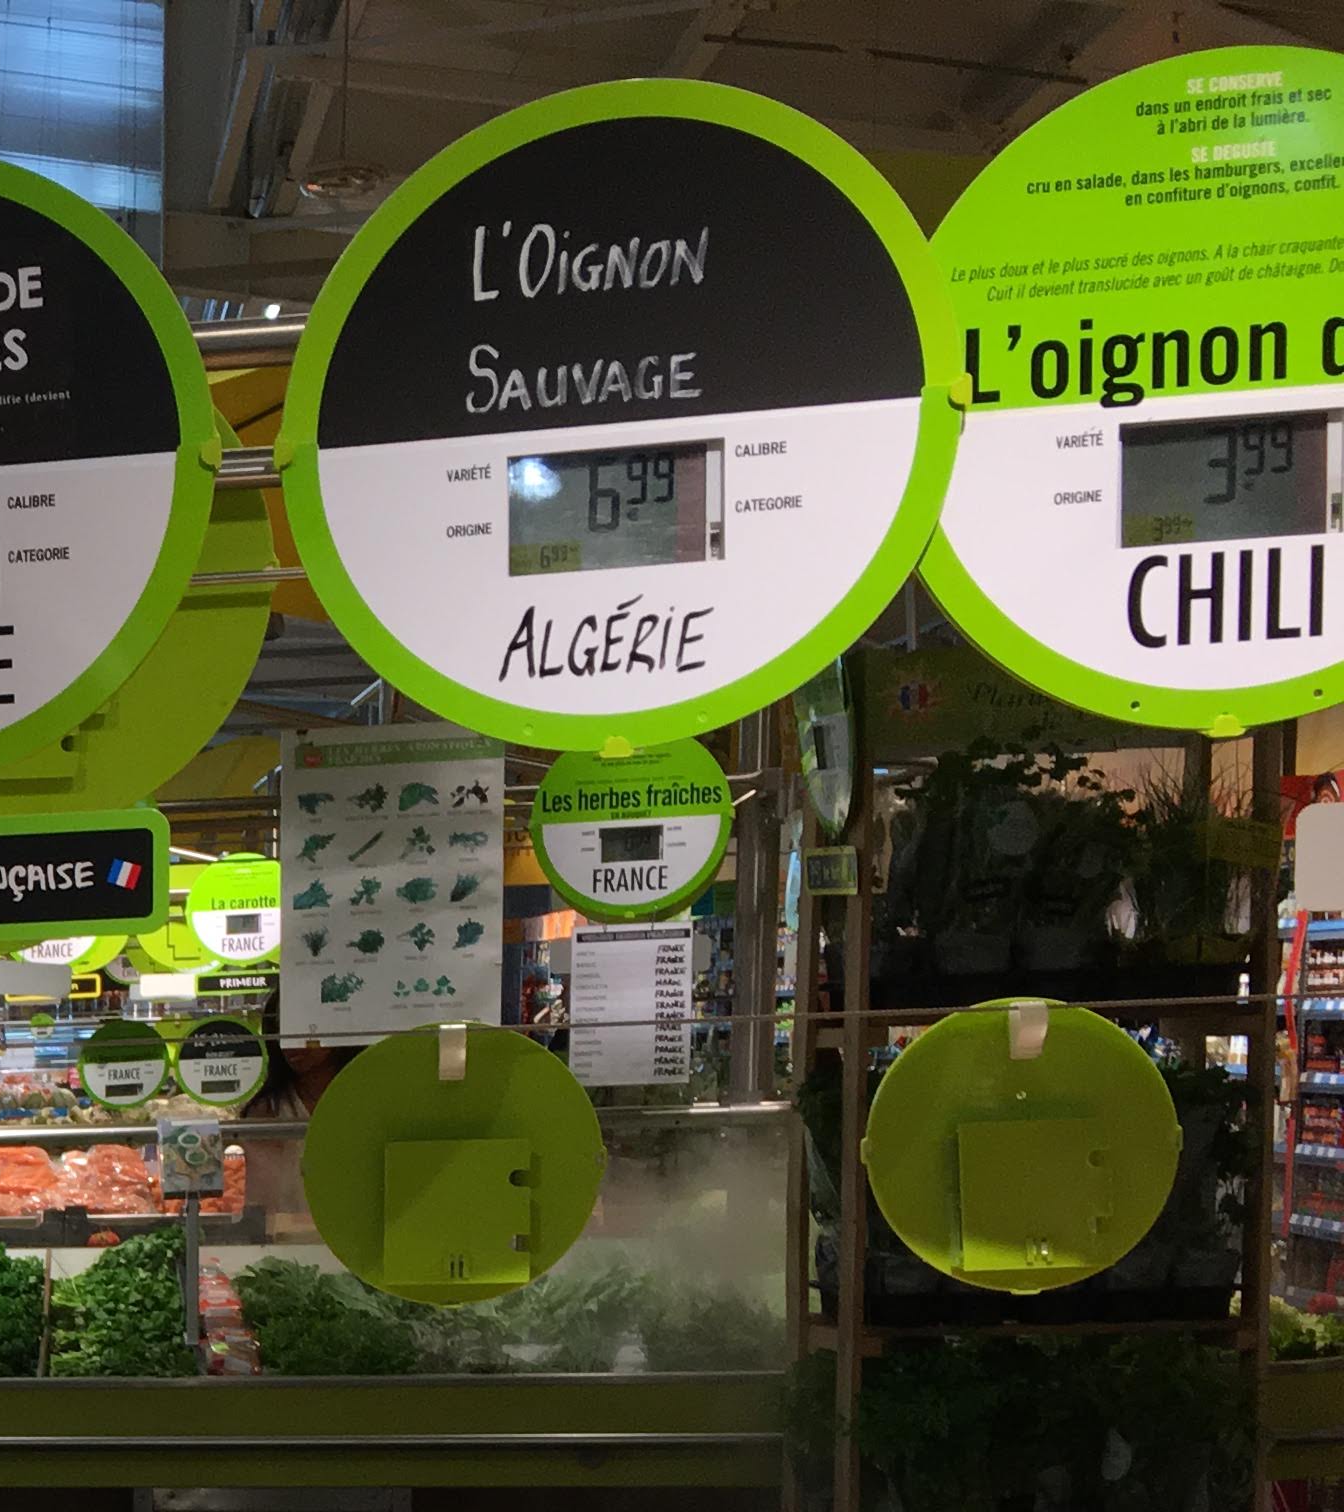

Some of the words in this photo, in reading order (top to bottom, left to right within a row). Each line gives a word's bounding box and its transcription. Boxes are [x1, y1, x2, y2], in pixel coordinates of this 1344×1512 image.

[1187, 78, 1204, 94] SE
[1208, 71, 1283, 92] CONSERVE
[1136, 102, 1169, 117] dans
[1174, 101, 1191, 113] un
[1195, 93, 1248, 111] endroit
[1250, 90, 1283, 106] frais
[1288, 90, 1302, 103] et
[1307, 87, 1332, 102] sec
[1157, 120, 1165, 135] à
[1170, 116, 1207, 134] l'abri
[1211, 115, 1228, 130] de
[1233, 114, 1246, 128] la
[1192, 147, 1208, 163] SE
[1027, 181, 1050, 195] cru
[1055, 179, 1072, 192] en
[1076, 173, 1126, 190] salade,
[1131, 170, 1164, 185] dans
[1169, 167, 1190, 183] les
[1194, 160, 1285, 182] hamburgers,
[1125, 193, 1142, 206] en
[1147, 186, 1211, 205] confiture
[1216, 181, 1289, 200] d'oignons,
[965, 320, 1288, 409] L'oignon
[467, 344, 703, 414] SAUVAGE
[1056, 428, 1103, 450] VARIÉTÉ
[735, 440, 787, 458] CALIBRE
[447, 463, 492, 481] VARIÉTÉ
[8, 493, 56, 510] CALIBRE
[735, 494, 803, 513] CATEGORIE
[1054, 490, 1103, 506] ORIGINE
[447, 522, 493, 538] ORIGINE
[8, 547, 70, 565] CATEGORIE
[1127, 544, 1325, 650] CHILI
[542, 790, 572, 813] Les
[578, 786, 641, 812] herbes
[646, 782, 722, 807] fraîches
[593, 865, 668, 893] FRANCE
[211, 898, 224, 910] La
[229, 895, 276, 909] carotte
[31, 943, 73, 958] FRANCE
[222, 936, 265, 952] FRANCE
[219, 977, 266, 988] PRIMEUR
[108, 1068, 140, 1081] FRANCE
[204, 1064, 237, 1076] FRANCE
